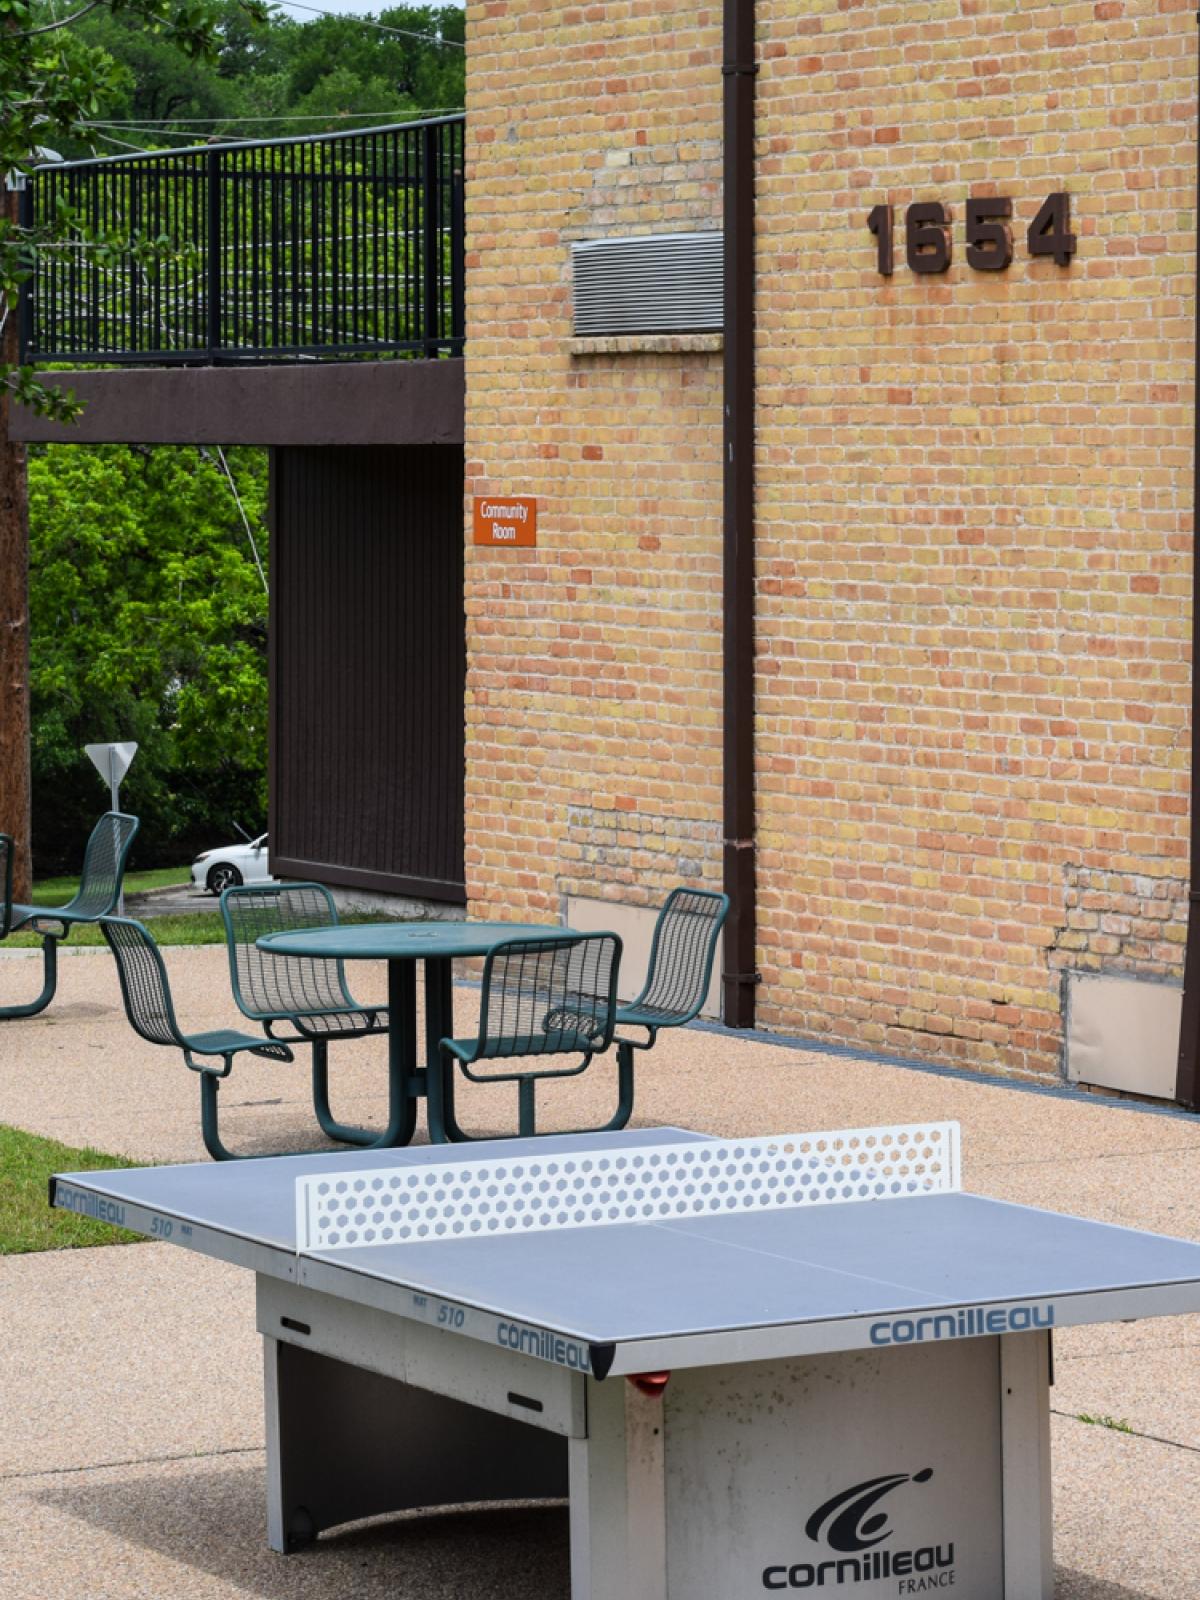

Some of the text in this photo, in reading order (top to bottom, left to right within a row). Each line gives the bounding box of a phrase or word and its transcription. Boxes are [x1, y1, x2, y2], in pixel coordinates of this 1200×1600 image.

[867, 192, 1078, 276] 1654
[481, 500, 529, 523] Community
[492, 521, 516, 540] Room
[56, 1185, 126, 1226] cornilleau
[151, 1216, 173, 1239] 510
[437, 1304, 464, 1328] 510
[497, 1322, 591, 1371] cornilleau
[869, 1304, 1055, 1345] cornilleau
[762, 1542, 955, 1590] cornilleau
[898, 1570, 956, 1596] FRANCE
